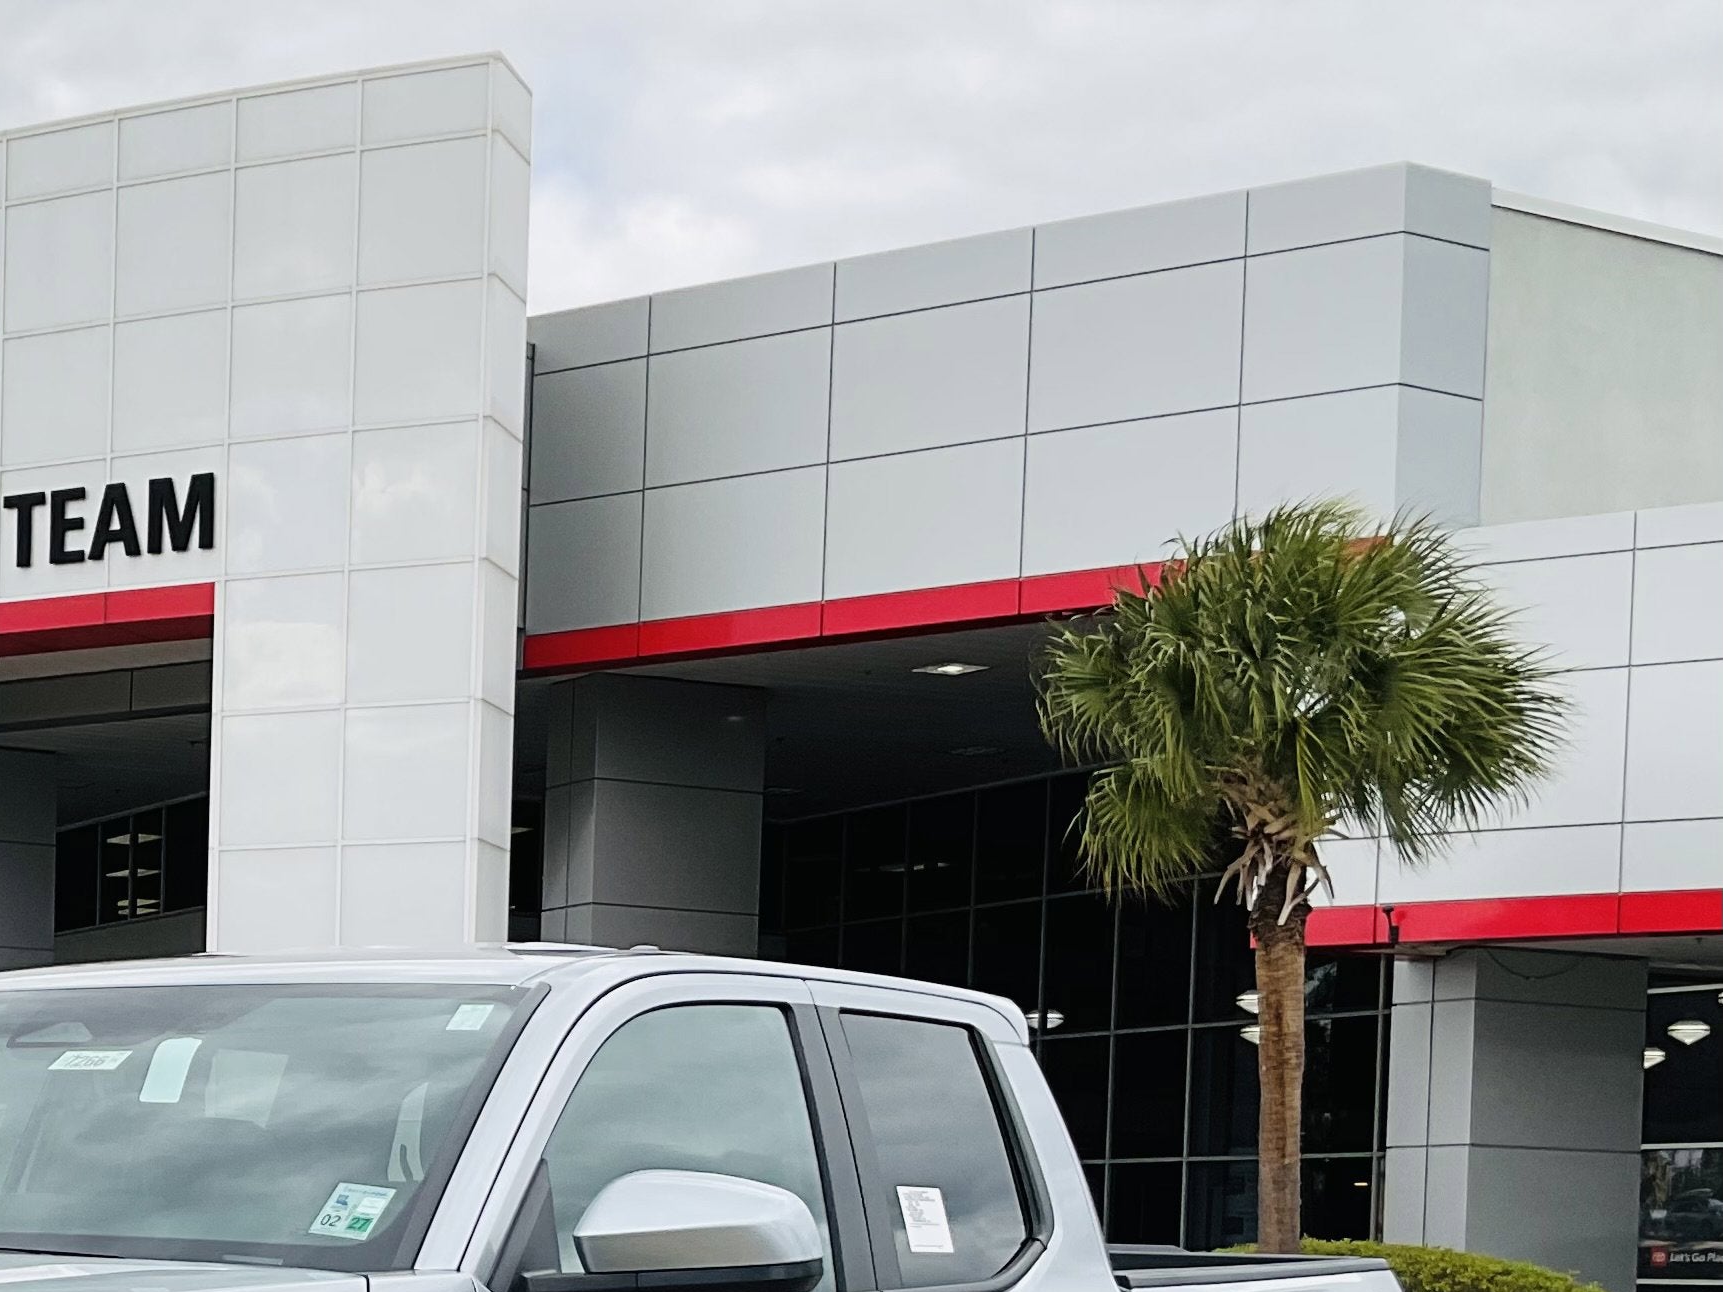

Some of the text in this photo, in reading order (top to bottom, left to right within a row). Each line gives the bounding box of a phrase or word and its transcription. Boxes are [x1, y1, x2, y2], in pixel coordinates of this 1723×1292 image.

[3, 473, 216, 568] TEAM
[320, 1213, 374, 1231] 02 27
[1691, 1252, 1706, 1263] Go
